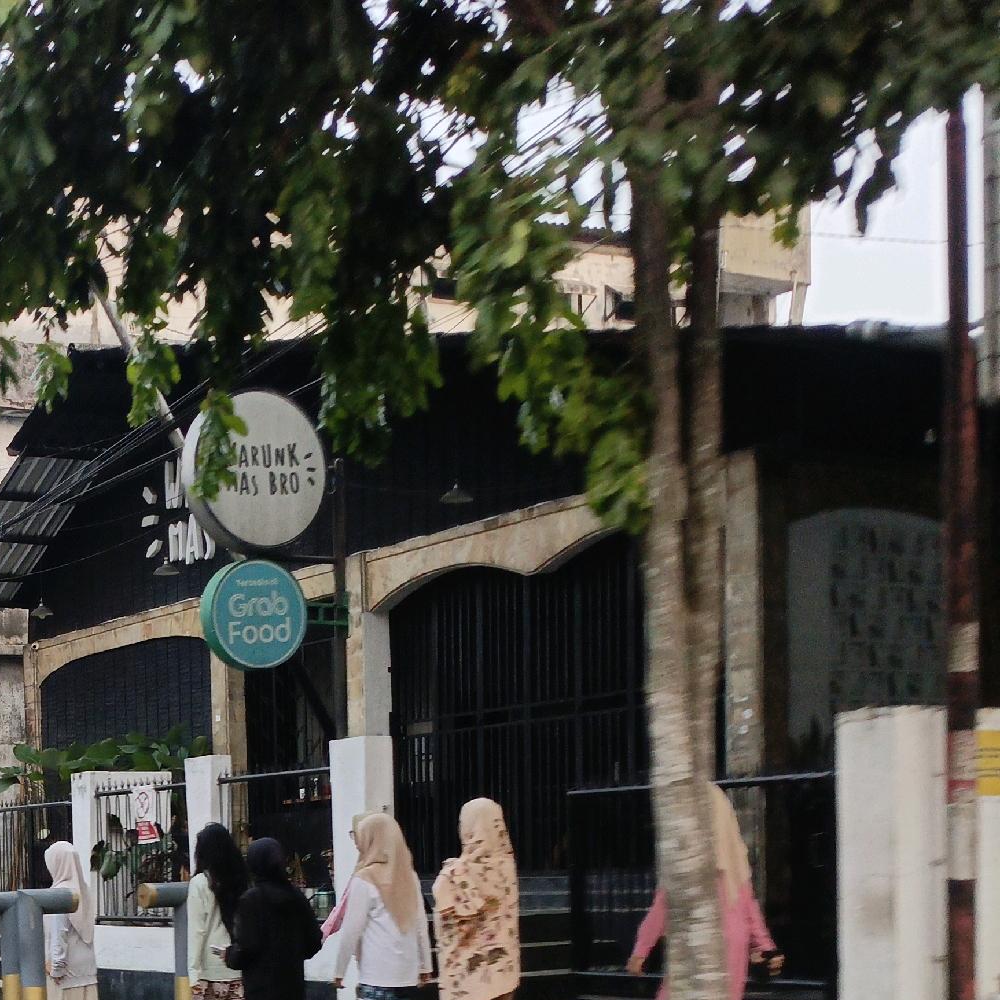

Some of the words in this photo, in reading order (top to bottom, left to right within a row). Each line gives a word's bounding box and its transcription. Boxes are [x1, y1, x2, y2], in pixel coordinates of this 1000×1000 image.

[232, 442, 300, 468] ARUNK
[269, 471, 300, 495] BRO
[228, 590, 289, 617] Grab
[228, 617, 292, 645] Food
